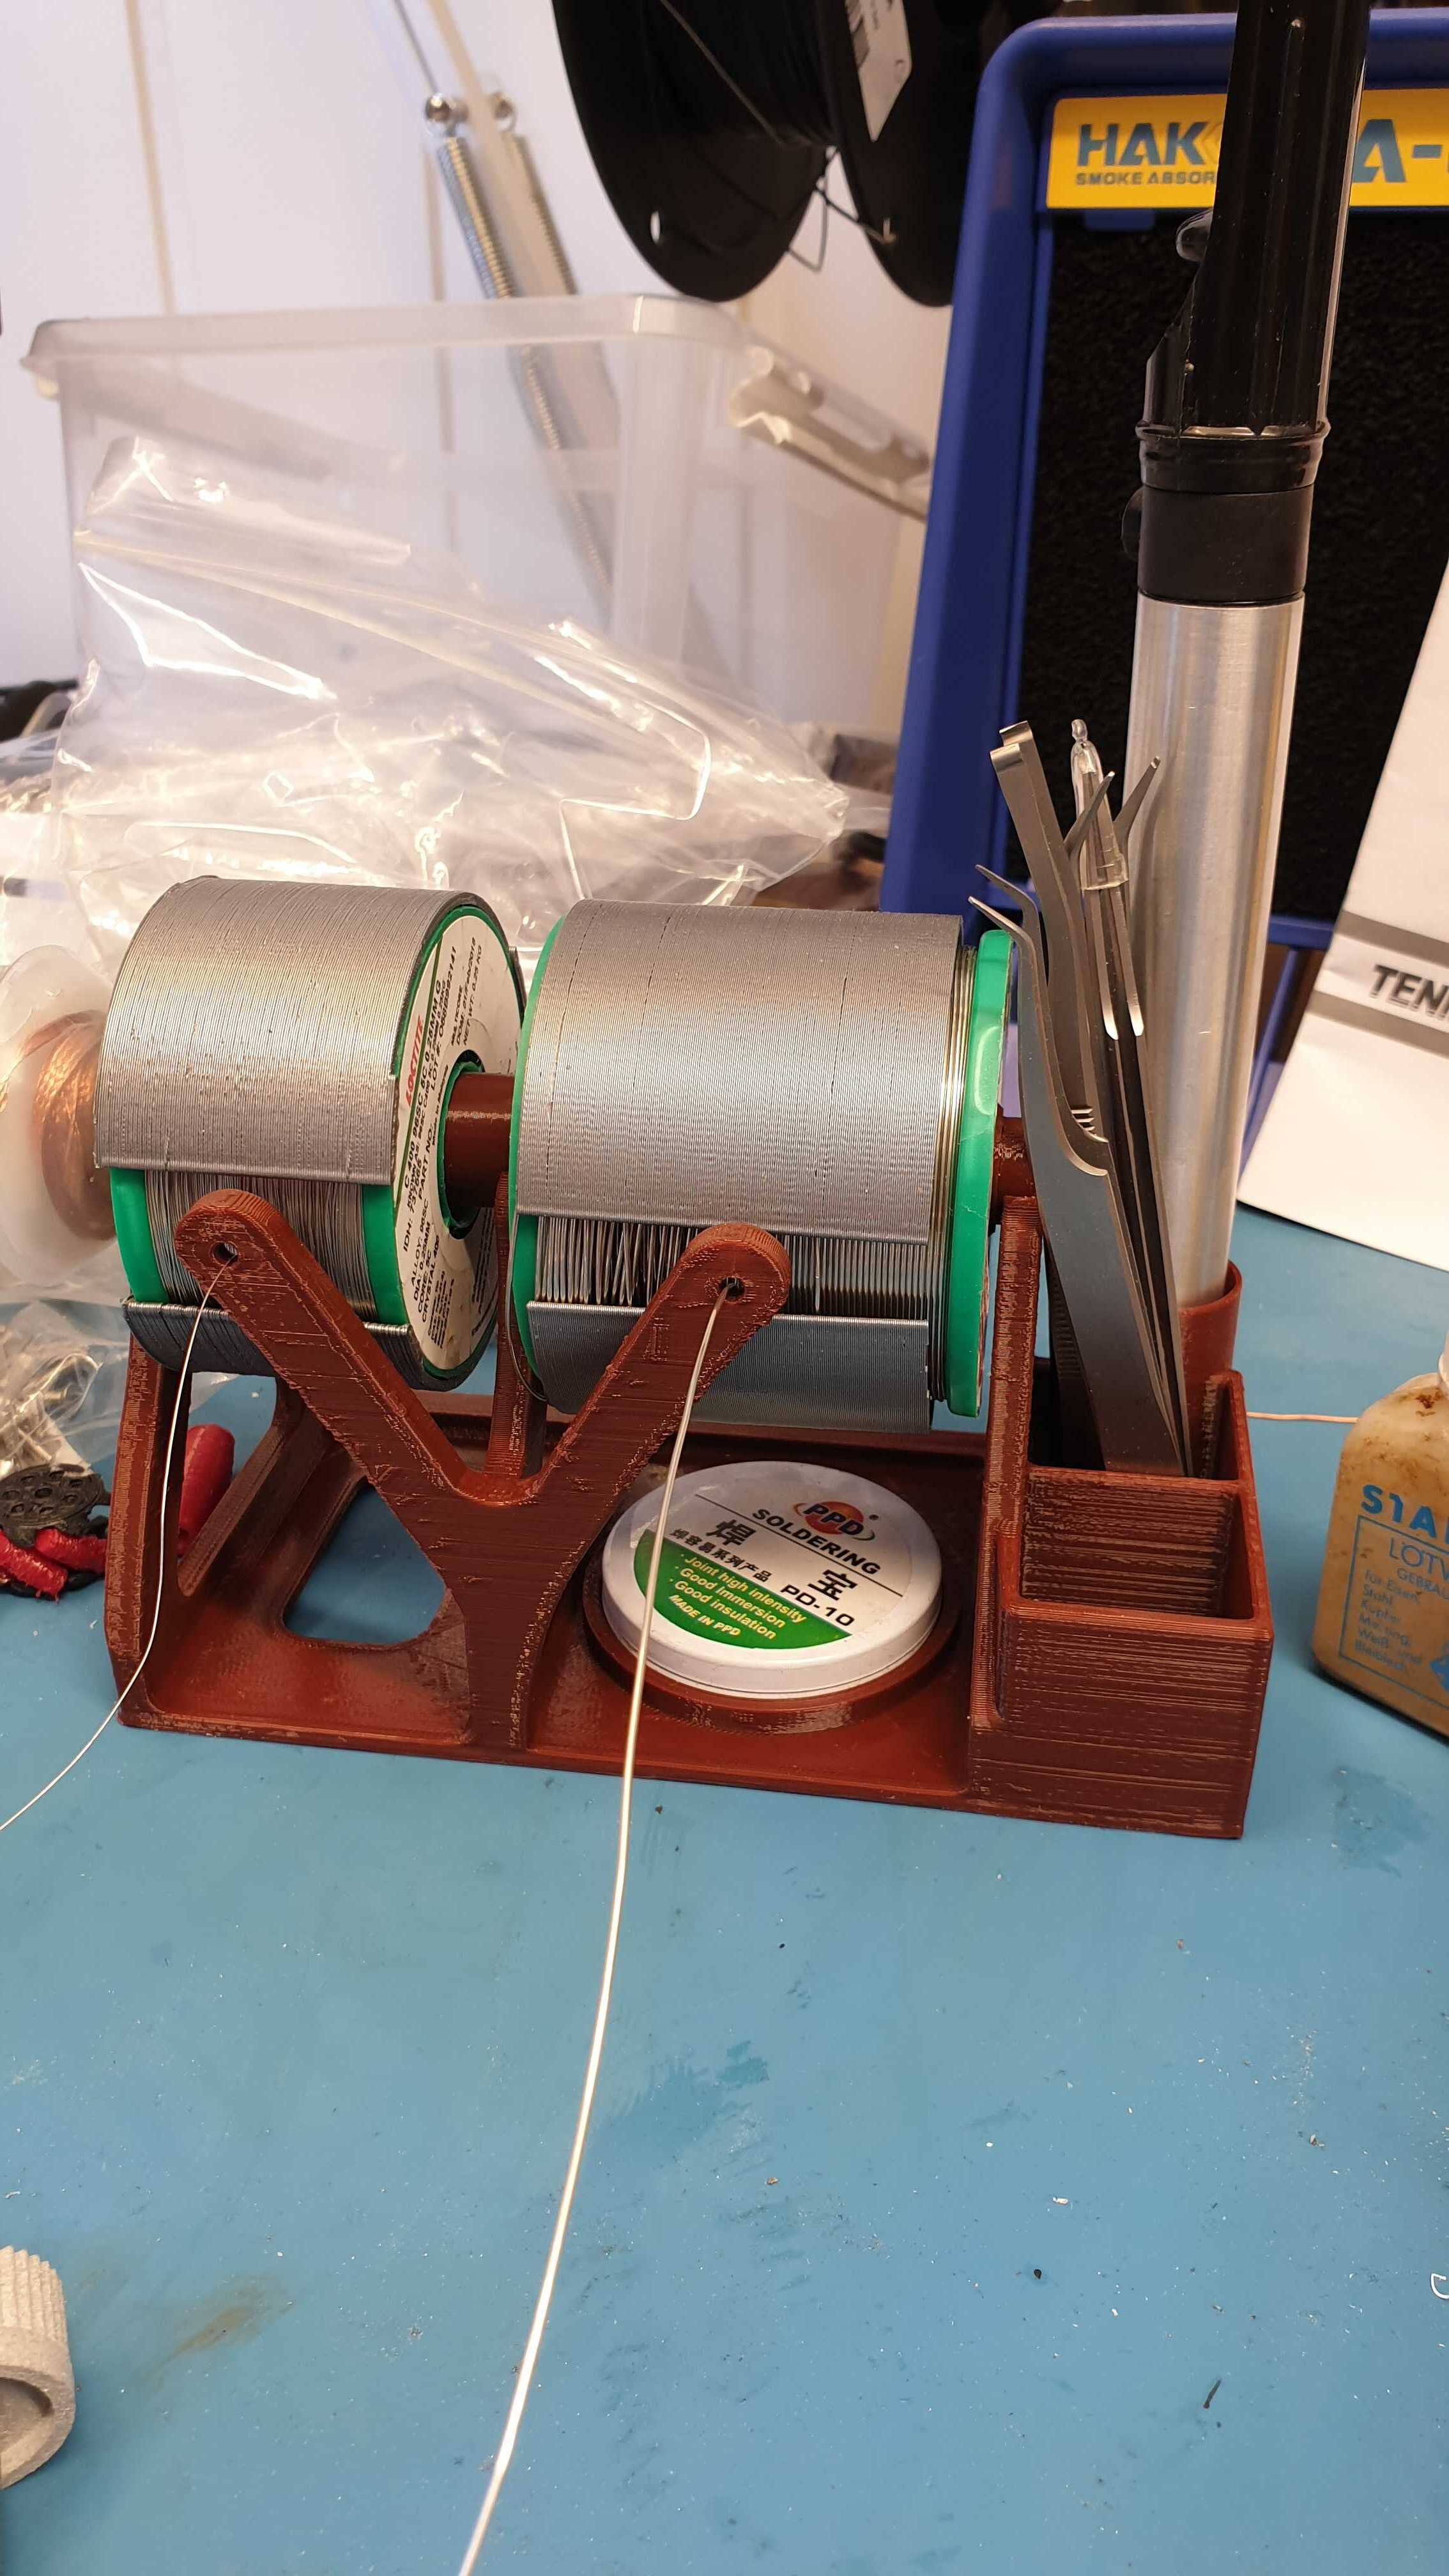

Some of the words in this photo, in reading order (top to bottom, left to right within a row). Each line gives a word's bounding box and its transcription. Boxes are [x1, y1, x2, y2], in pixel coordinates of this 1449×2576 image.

[1077, 121, 1208, 167] HAK
[1351, 119, 1449, 183] A-
[1076, 172, 1142, 186] SMOKE
[476, 944, 482, 964] KG
[404, 1174, 409, 1188] C
[434, 979, 441, 995] G
[405, 1014, 423, 1107] LOCTITE
[407, 1163, 416, 1208] KNOWN
[418, 1154, 428, 1200] PART
[403, 1218, 412, 1252] IDH:
[419, 1220, 431, 1270] 0.25MM
[411, 1236, 422, 1286] ALLOY:
[417, 1270, 428, 1313] CORE:
[422, 1262, 435, 1322] CRYSTAL
[803, 1503, 864, 1535] PPD
[1361, 1484, 1449, 1544] STA
[706, 1519, 756, 1545] 焊
[807, 1568, 858, 1601] 宝
[752, 1508, 881, 1575] SOLDERING
[680, 1568, 717, 1590] Good
[685, 1557, 719, 1577] Joint
[718, 1572, 748, 1591] high
[669, 1594, 700, 1618] MADE
[697, 1614, 714, 1626] IN
[713, 1621, 741, 1636] PPD
[675, 1581, 712, 1603] Good
[710, 1599, 777, 1639] insulation
[780, 1584, 855, 1627] PD-10
